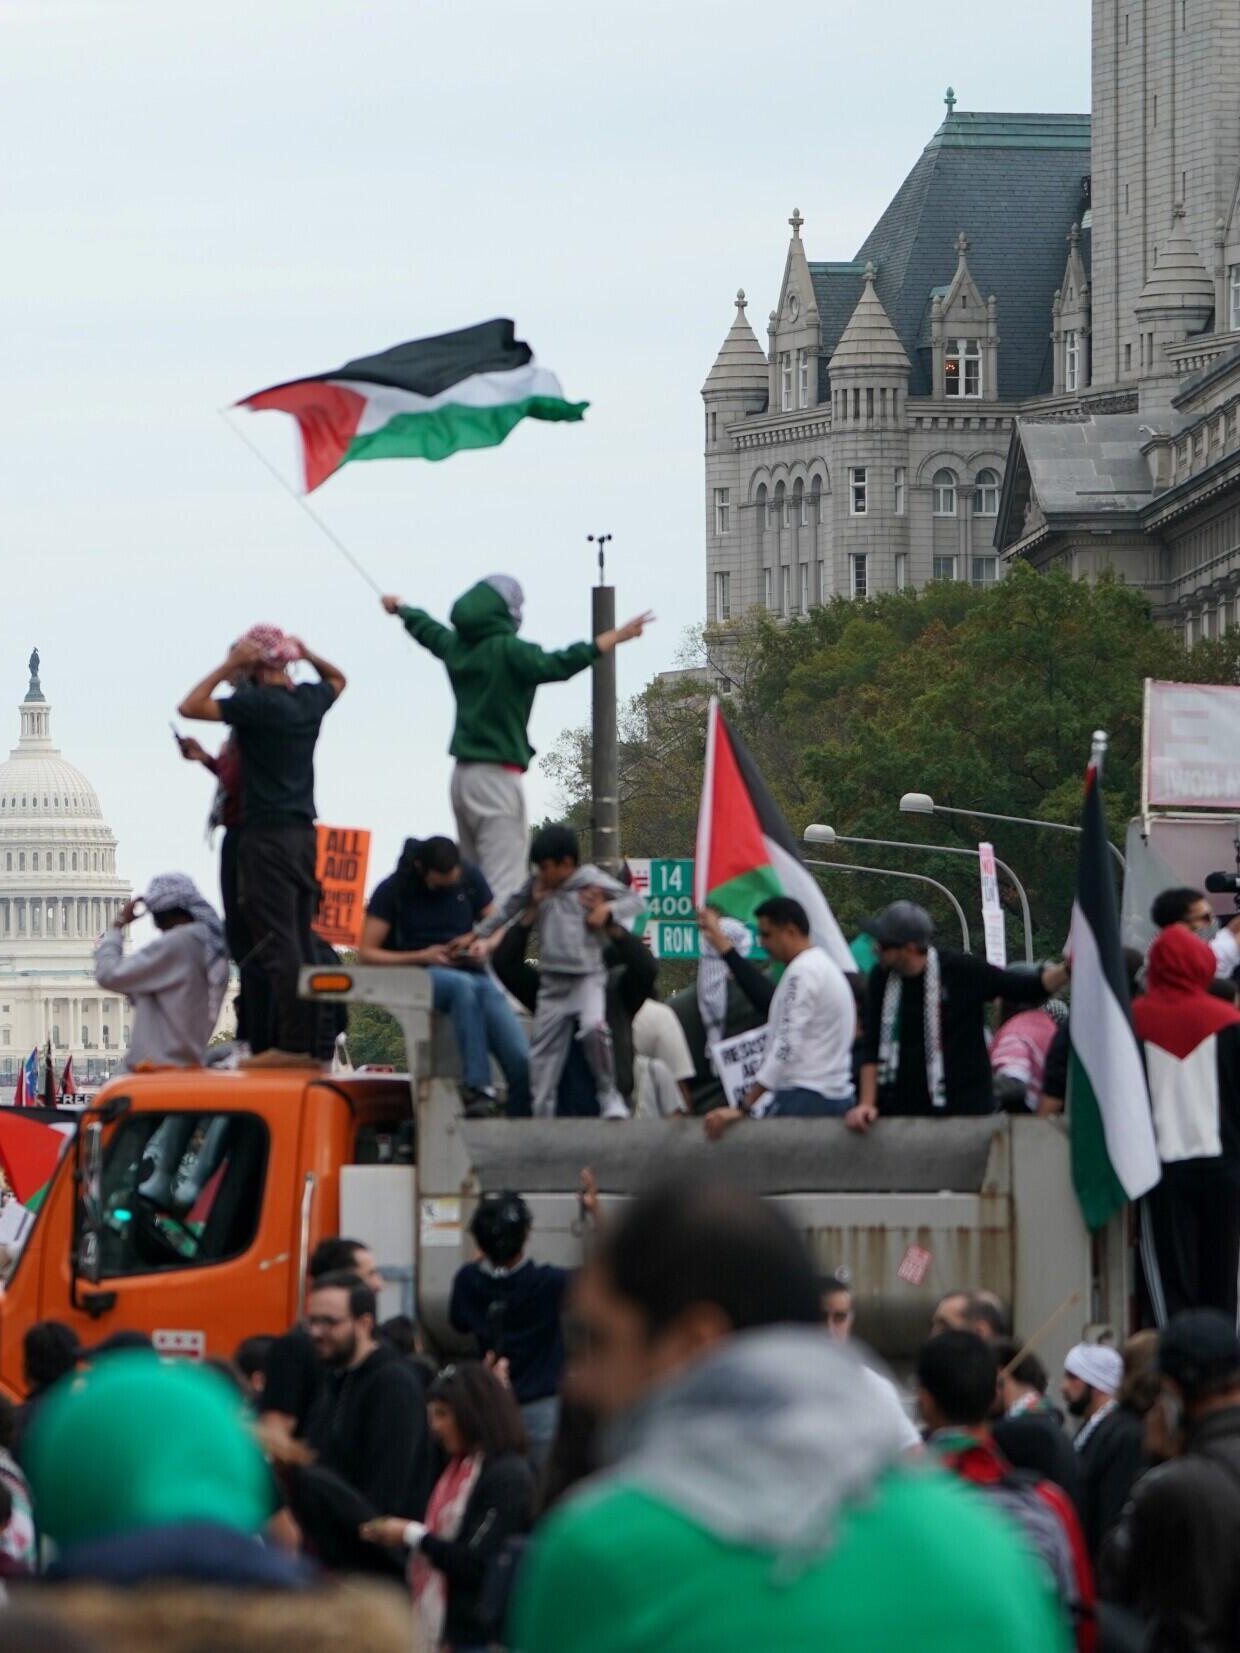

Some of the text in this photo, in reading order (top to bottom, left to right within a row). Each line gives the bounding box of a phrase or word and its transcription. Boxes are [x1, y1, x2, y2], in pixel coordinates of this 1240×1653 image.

[326, 831, 361, 855] ALL
[325, 857, 357, 881] AID
[660, 864, 683, 892] 14
[648, 896, 692, 915] 400
[663, 925, 694, 953] RON
